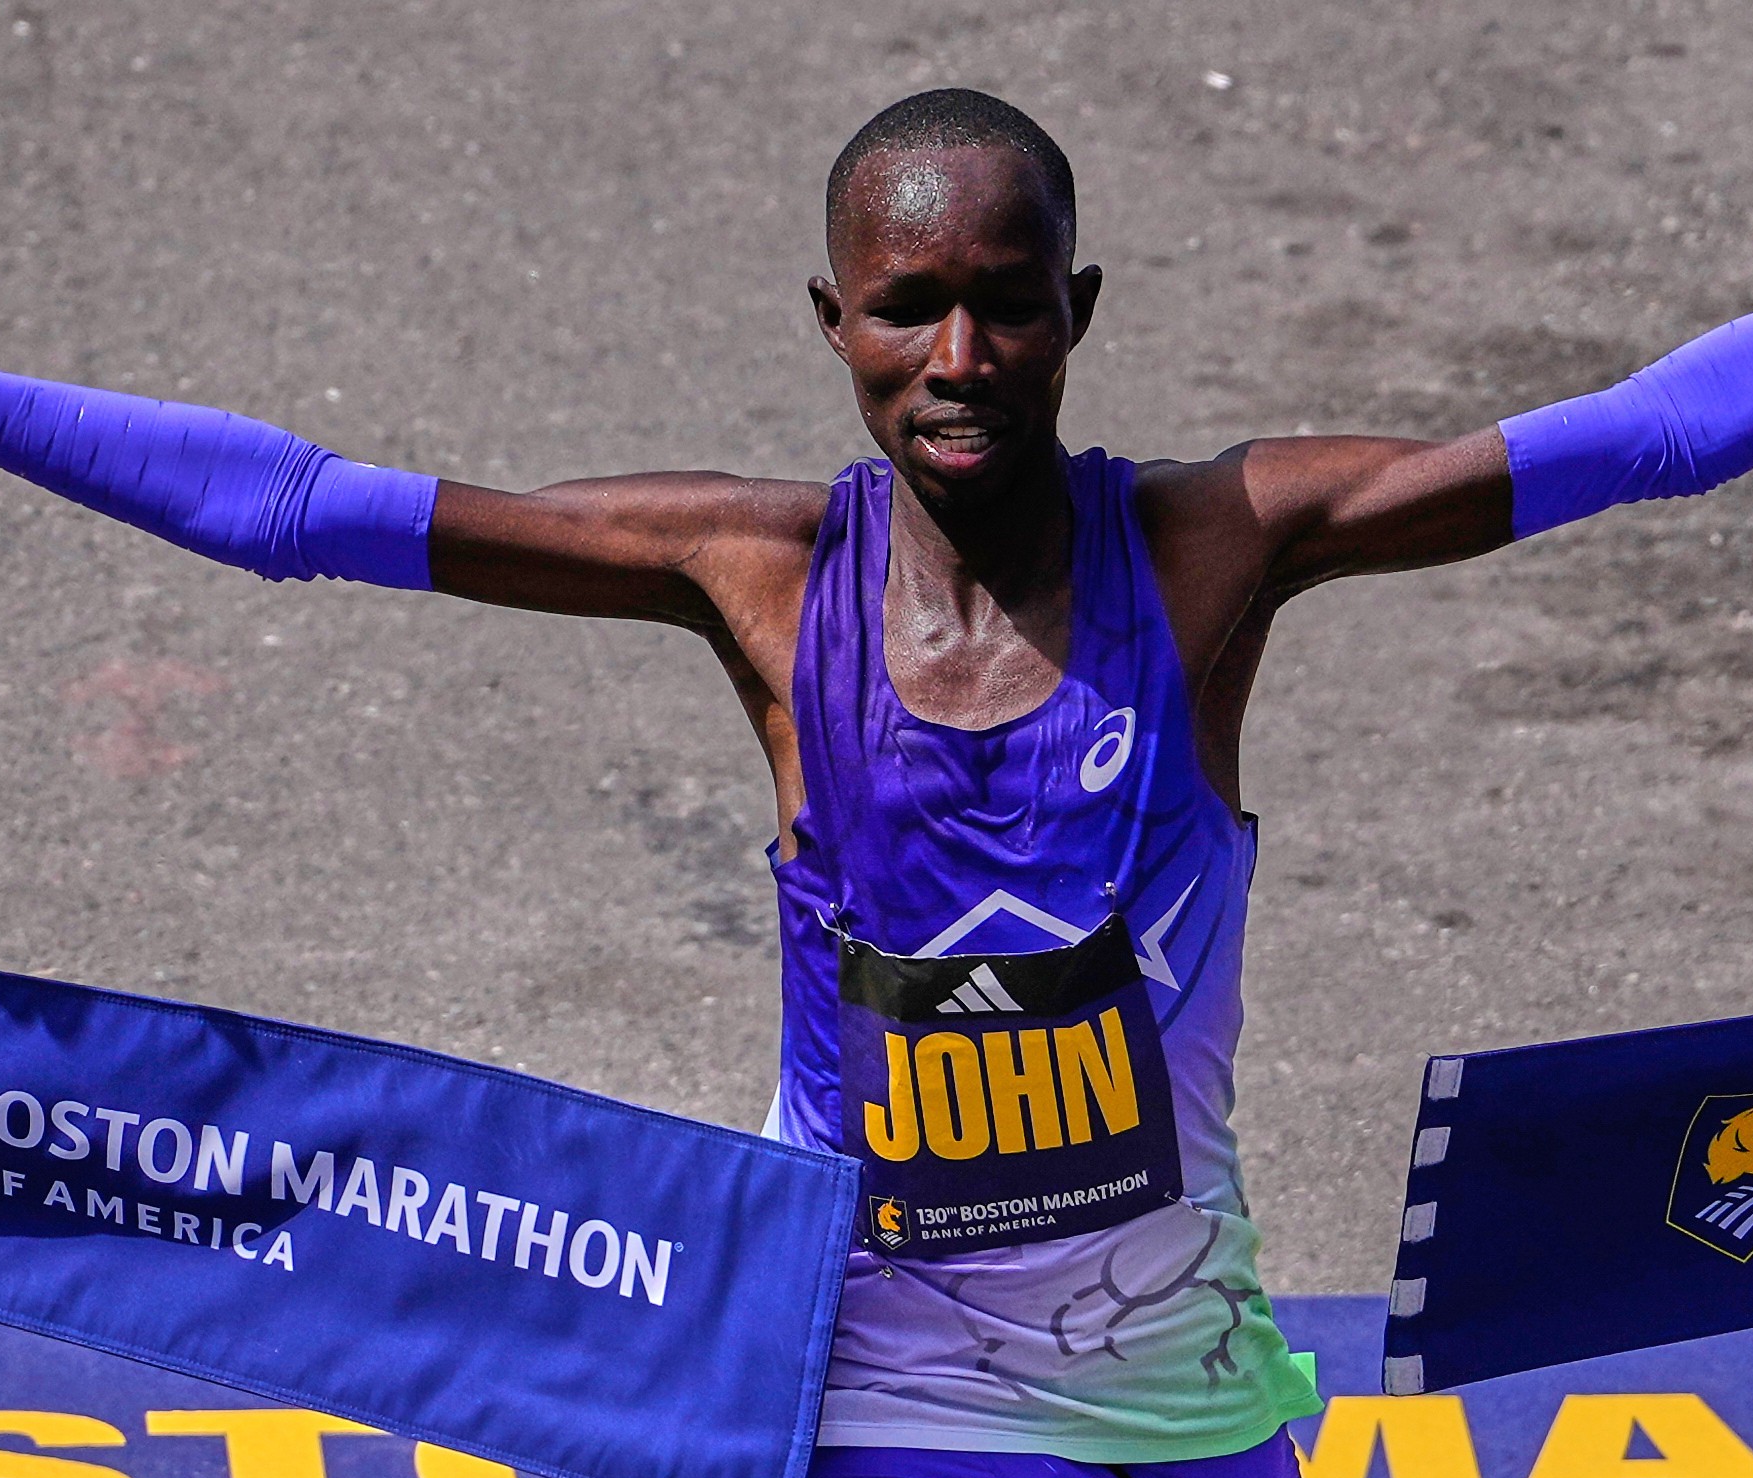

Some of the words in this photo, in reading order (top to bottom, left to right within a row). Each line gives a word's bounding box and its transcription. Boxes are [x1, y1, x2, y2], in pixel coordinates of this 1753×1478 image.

[863, 1006, 1141, 1162] JOHN
[42, 1179, 295, 1273] AMERICA
[270, 1139, 674, 1308] MARATHON
[921, 1227, 963, 1241] BANK
[965, 1224, 985, 1236] OF
[988, 1214, 1057, 1235] AMERICA
[959, 1196, 1038, 1222] BOSTON
[1042, 1169, 1149, 1212] MARATHON
